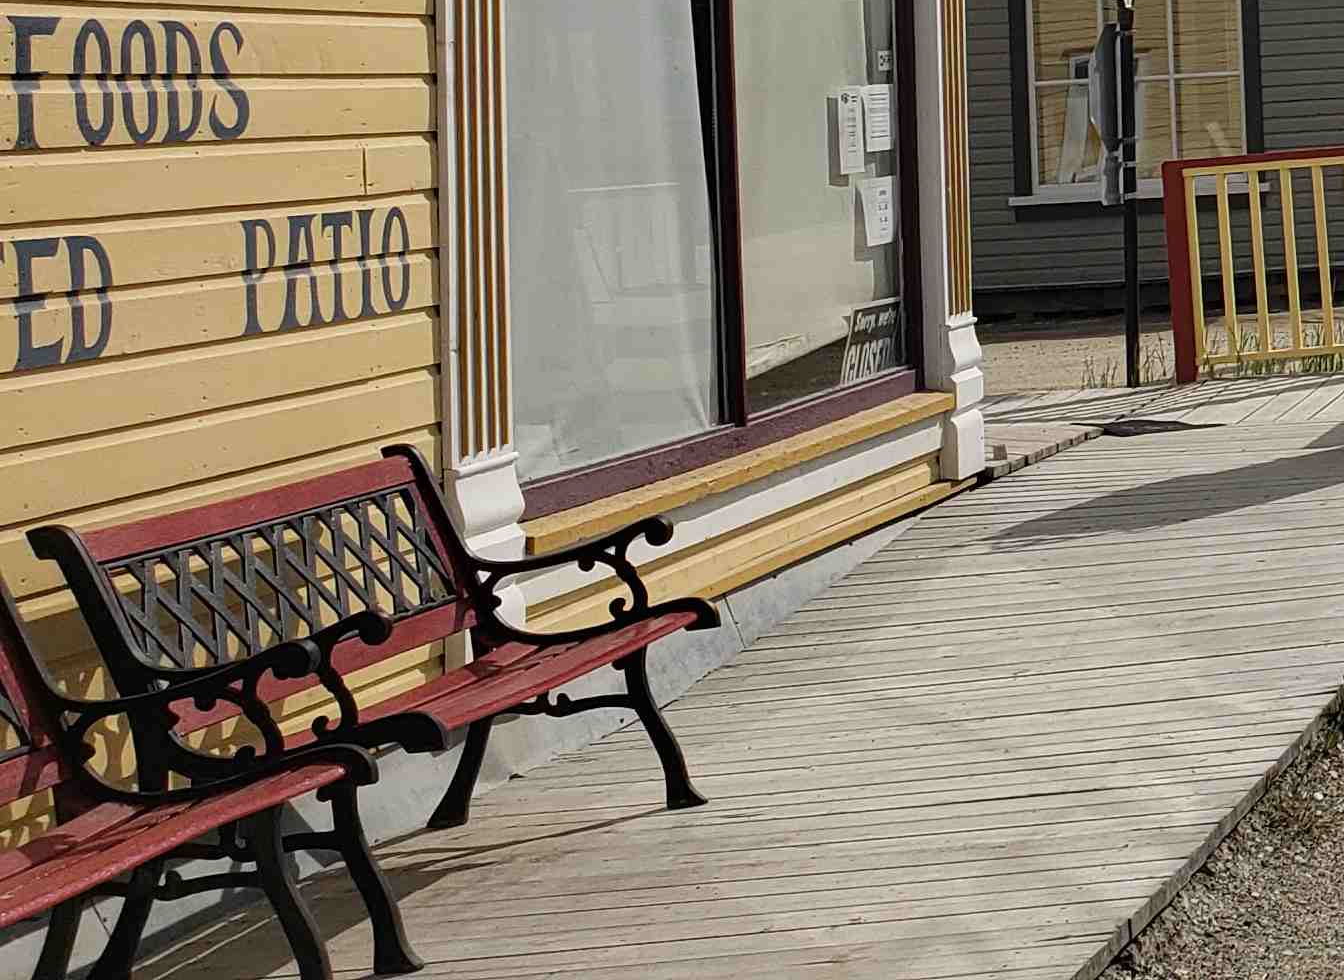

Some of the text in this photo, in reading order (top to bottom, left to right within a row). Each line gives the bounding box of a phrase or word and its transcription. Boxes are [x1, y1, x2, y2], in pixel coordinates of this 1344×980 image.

[7, 16, 250, 151] FOODS
[0, 206, 411, 372] ED PATIO
